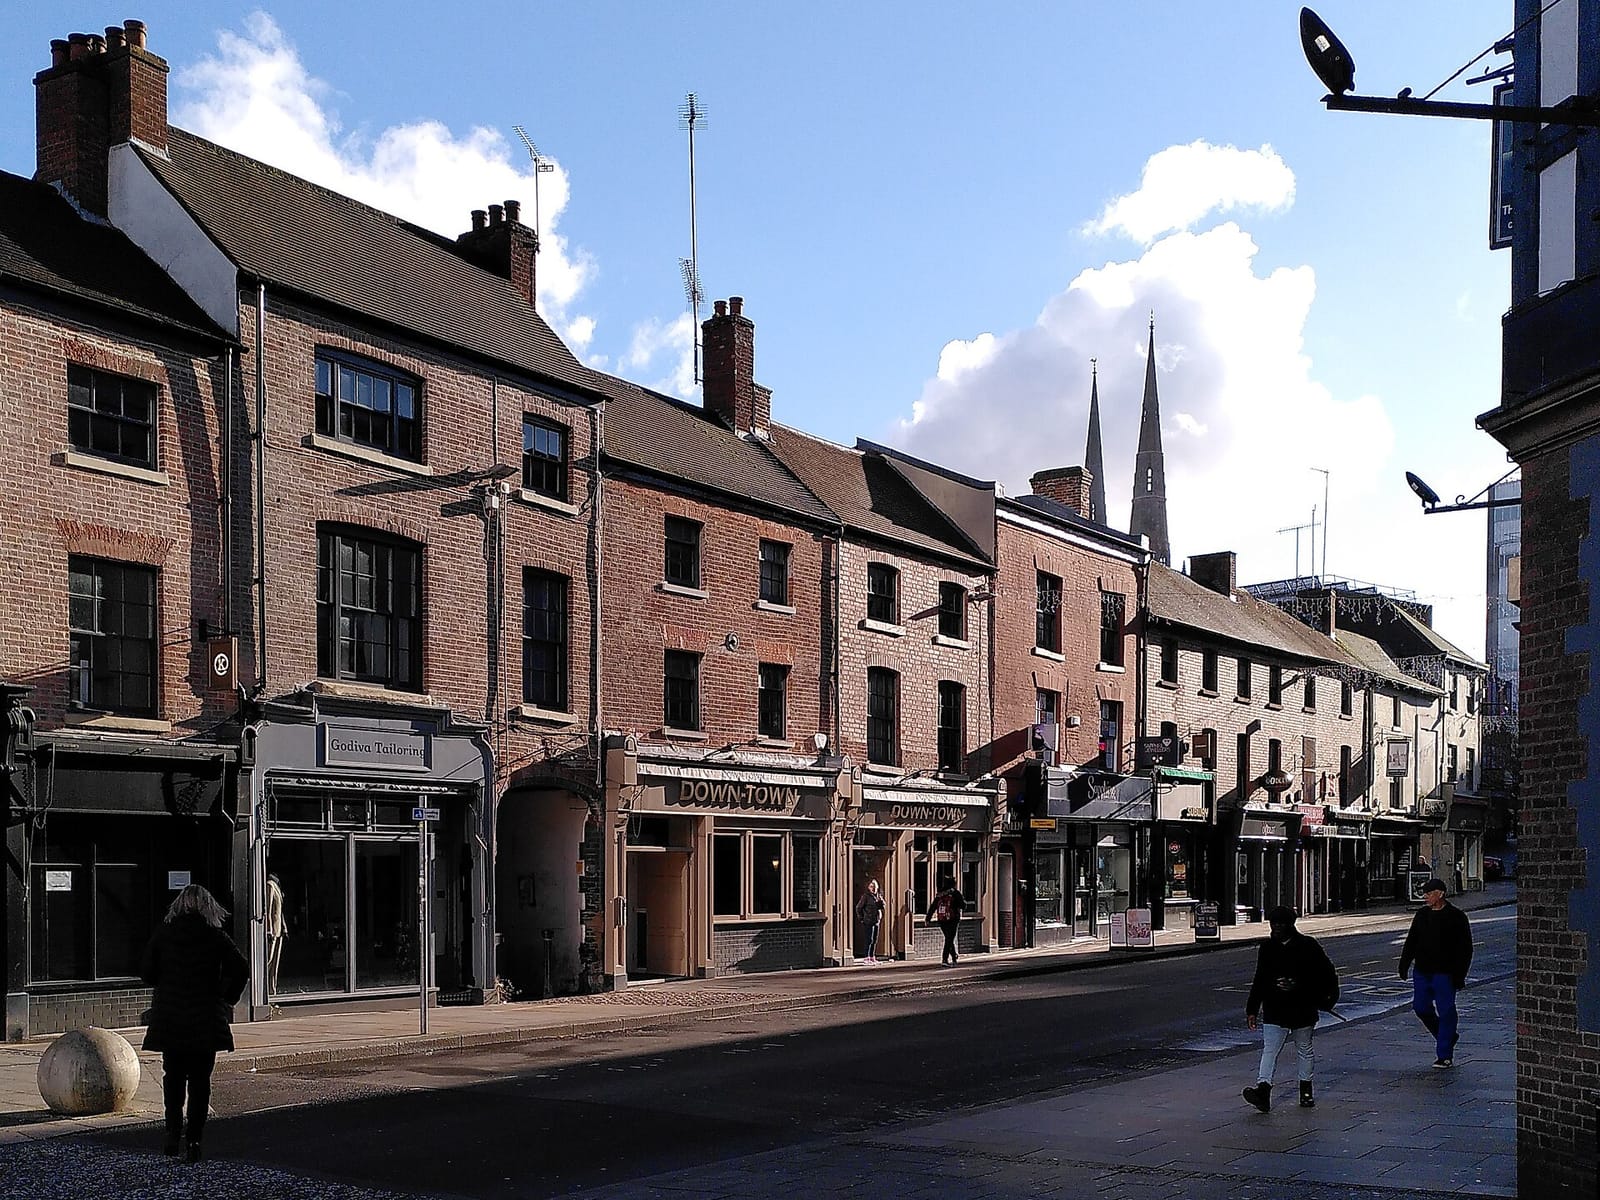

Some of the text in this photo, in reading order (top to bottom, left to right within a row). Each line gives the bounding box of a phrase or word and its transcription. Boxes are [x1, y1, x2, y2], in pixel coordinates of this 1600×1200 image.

[330, 738, 425, 759] Godiva Tailoring
[679, 779, 801, 806] DOWN-TOWN
[890, 804, 967, 821] DOWN-TOWN
